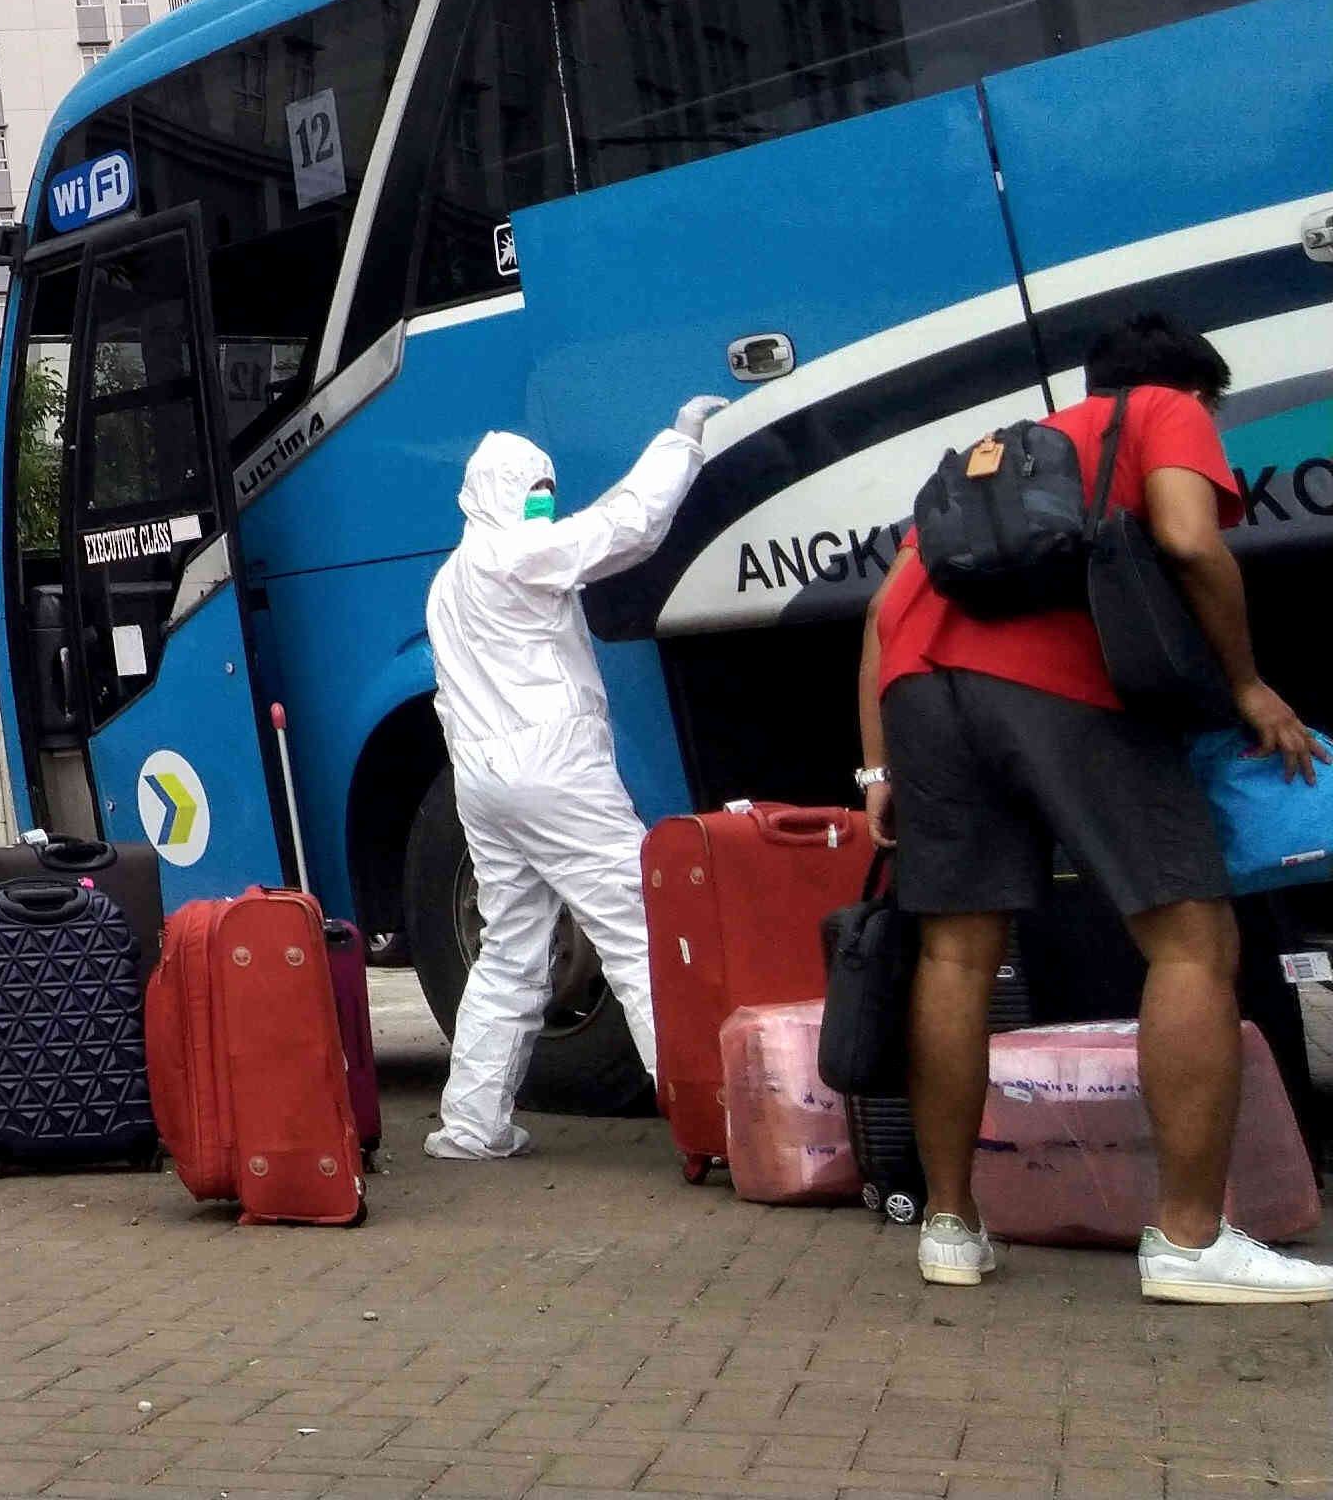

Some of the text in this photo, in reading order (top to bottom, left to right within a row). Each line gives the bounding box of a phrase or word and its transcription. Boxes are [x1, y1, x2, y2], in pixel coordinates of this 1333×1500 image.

[296, 112, 334, 168] 12
[84, 518, 172, 565] EXECUTIVE CLASS
